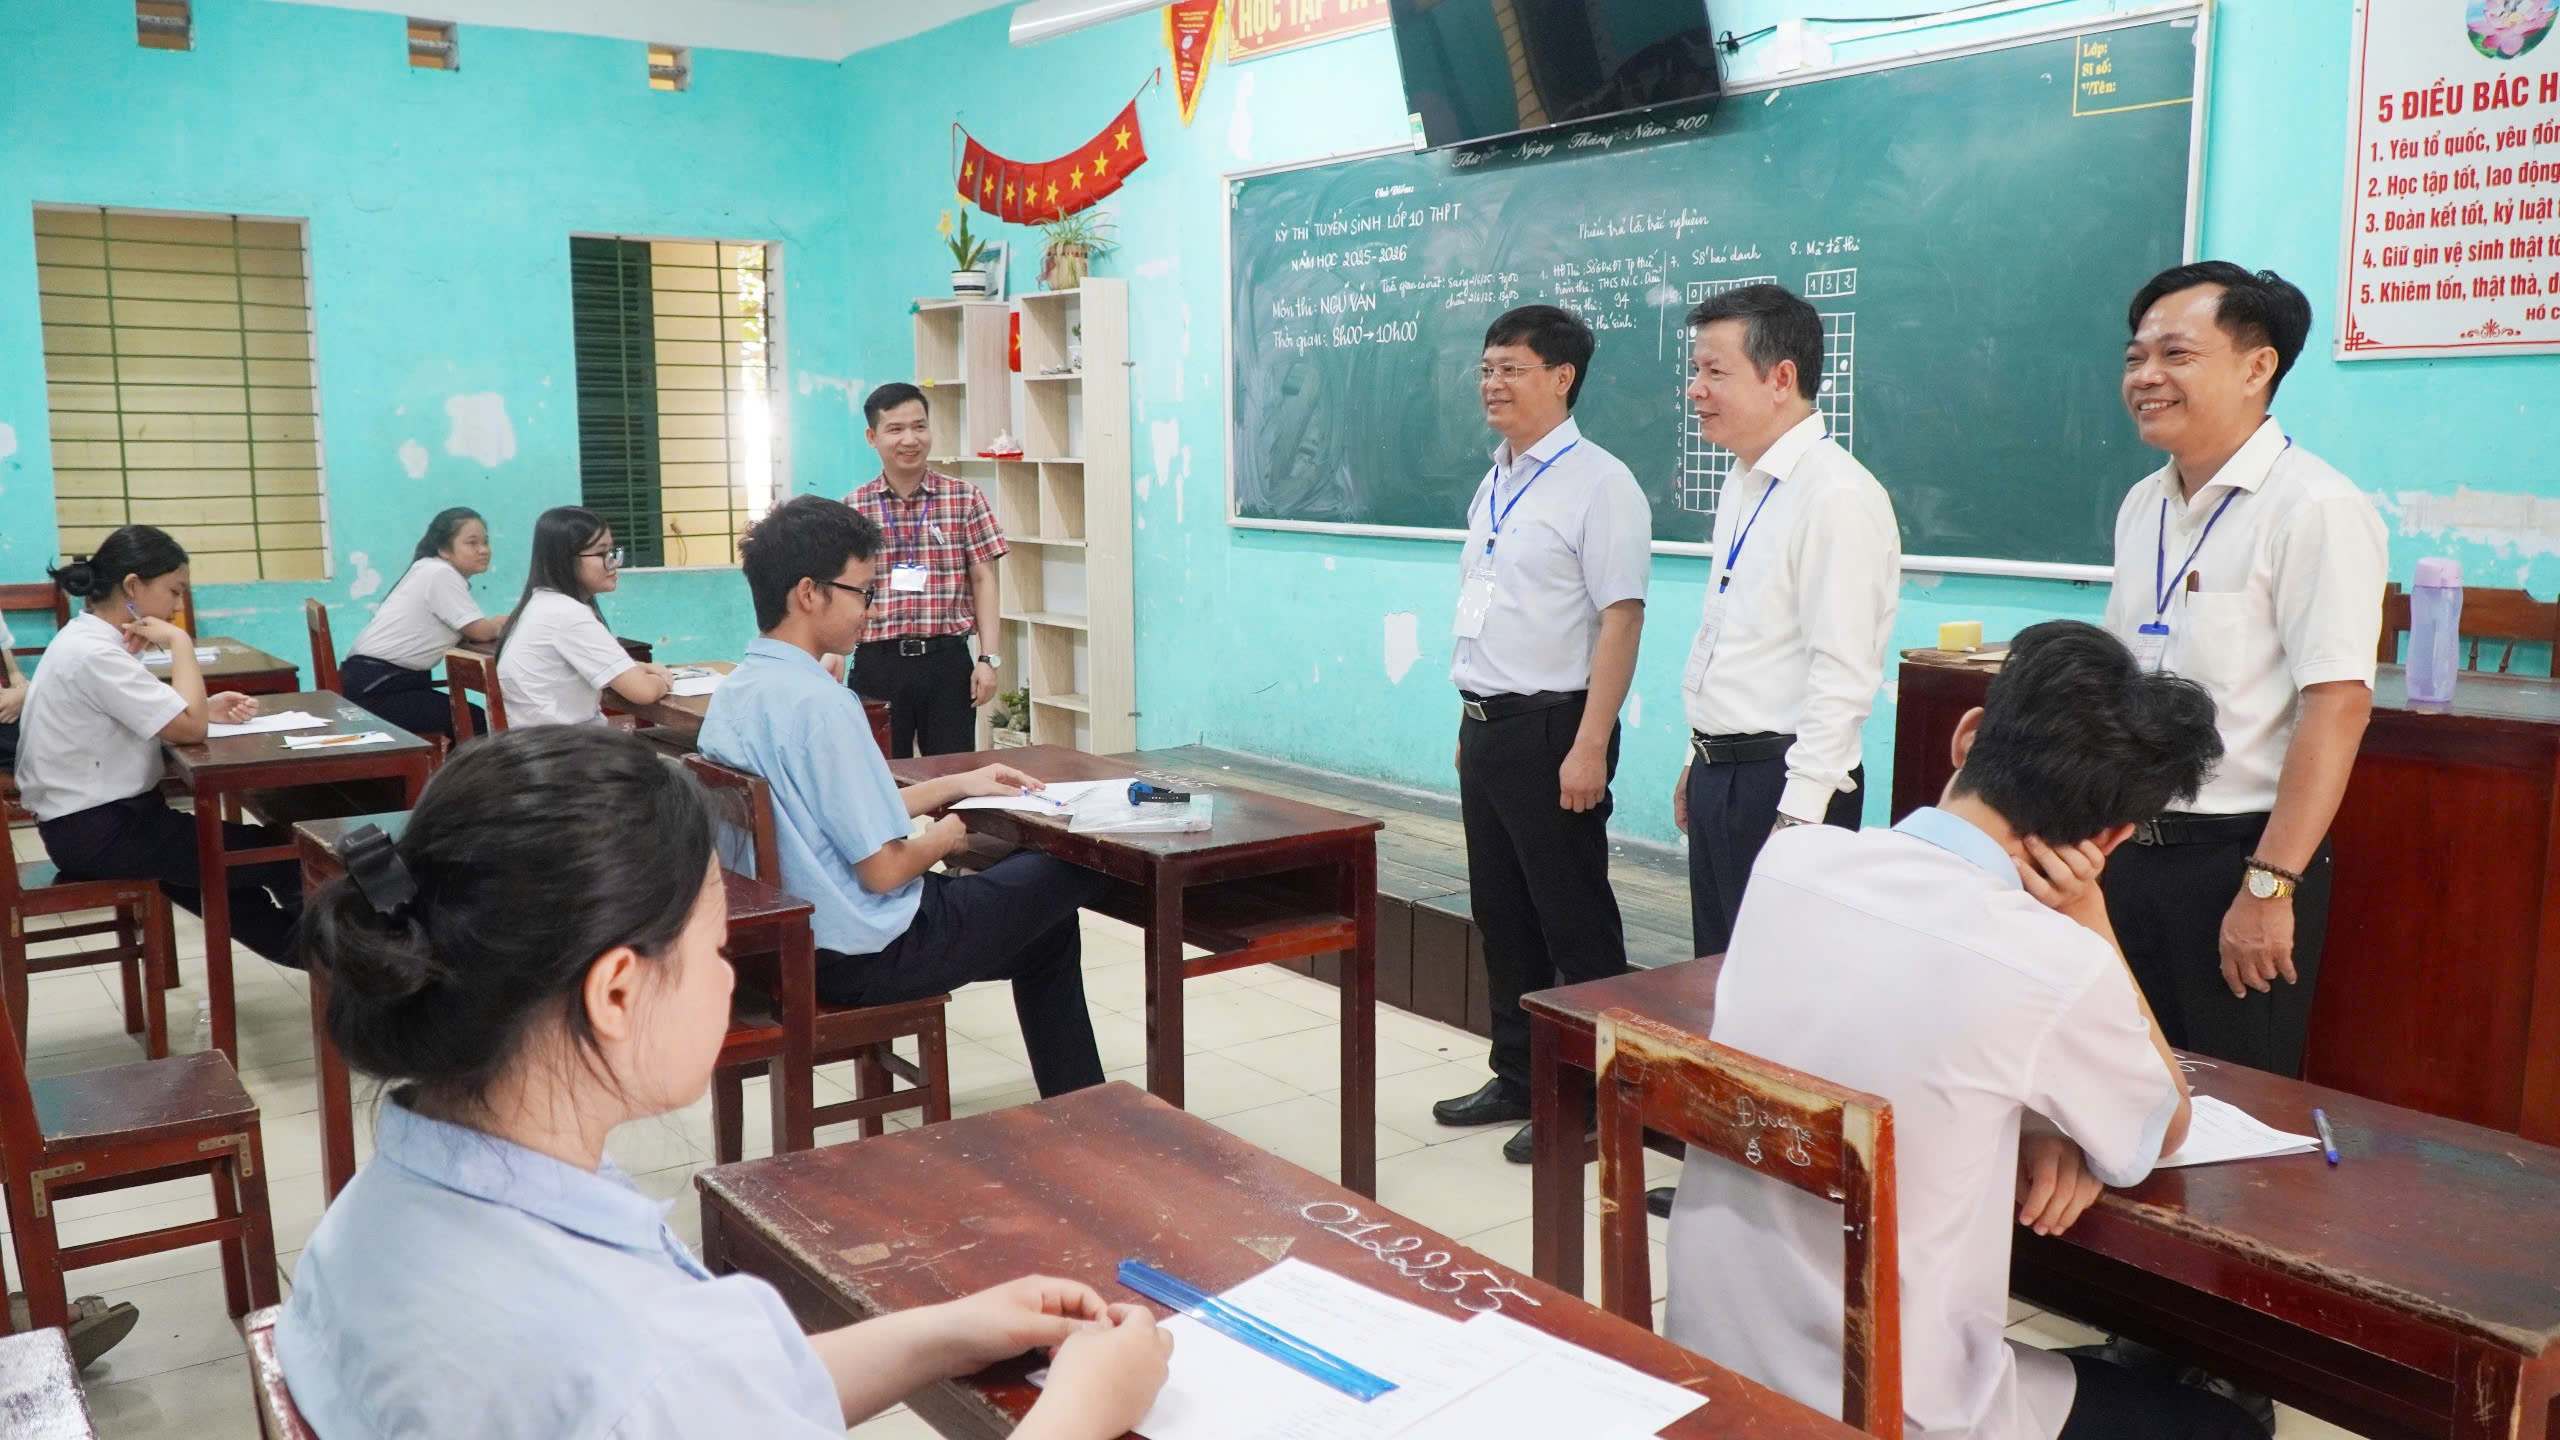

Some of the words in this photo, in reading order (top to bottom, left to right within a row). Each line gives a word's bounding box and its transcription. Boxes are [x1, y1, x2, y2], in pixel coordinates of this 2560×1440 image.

[2083, 42, 2108, 57] Lớp:
[2378, 95, 2393, 123] 5
[2402, 77, 2464, 121] ĐIỀU
[2472, 72, 2530, 112] BÁC
[2539, 71, 2560, 104] H
[1512, 140, 1554, 160] Ngày
[1568, 132, 1615, 149] Tháng
[1626, 121, 1667, 141] Năm
[2370, 142, 2384, 162] 1.
[2390, 138, 2419, 161] Yêu
[2424, 130, 2441, 157] tổ
[2444, 127, 2490, 157] quốc,
[2496, 126, 2527, 153] yêu
[2368, 177, 2382, 198] 2.
[2387, 175, 2417, 200] Học
[2423, 171, 2448, 197] tập
[2454, 165, 2480, 191] tốt,
[2486, 165, 2513, 187] lao
[2518, 160, 2560, 188] động
[2365, 213, 2379, 233] 3.
[2385, 208, 2426, 231] Đoàn
[2430, 202, 2457, 228] kết
[2461, 200, 2488, 226] tốt,
[2493, 198, 2514, 225] kỷ
[2519, 197, 2552, 225] luật
[1275, 222, 1289, 243] KỲ
[1314, 208, 1348, 238] TUYỂN
[1408, 210, 1424, 228] 10
[1730, 243, 1762, 261] danh
[1806, 241, 1825, 256] Mã
[1844, 235, 1861, 252] thi
[2362, 248, 2377, 269] 4.
[2382, 245, 2409, 267] Giữ
[2444, 241, 2463, 268] vệ
[2468, 239, 2504, 262] sinh
[2509, 235, 2543, 262] thật
[1291, 249, 1315, 272] NĂM
[1316, 253, 1338, 273] HỌC
[1342, 245, 1409, 268] 2025-2026
[1598, 277, 1619, 291] THCS
[1810, 279, 1817, 291] 1
[1826, 276, 1833, 290] 3
[1845, 275, 1853, 289] 2
[2361, 284, 2375, 304] 5.
[2380, 281, 2431, 303] Khiêm
[2436, 275, 2466, 302] tốn,
[2472, 275, 2506, 302] thật
[1272, 298, 1293, 318] Môn
[1295, 297, 1317, 317] thi:
[1350, 282, 1377, 313] VĂN
[1614, 292, 1630, 310] 94
[1690, 288, 1698, 299] 0
[1704, 286, 1711, 297] 1
[1296, 330, 1328, 357] gian:
[1676, 329, 1684, 340] 0
[1675, 364, 1682, 375] 2
[1675, 384, 1682, 397] 3
[1675, 401, 1682, 412] 4
[1677, 422, 1683, 433] 5
[1677, 437, 1683, 448] 6
[1676, 456, 1683, 468] 7
[1676, 476, 1683, 488] 8
[1301, 1202, 1542, 1314] 012255
